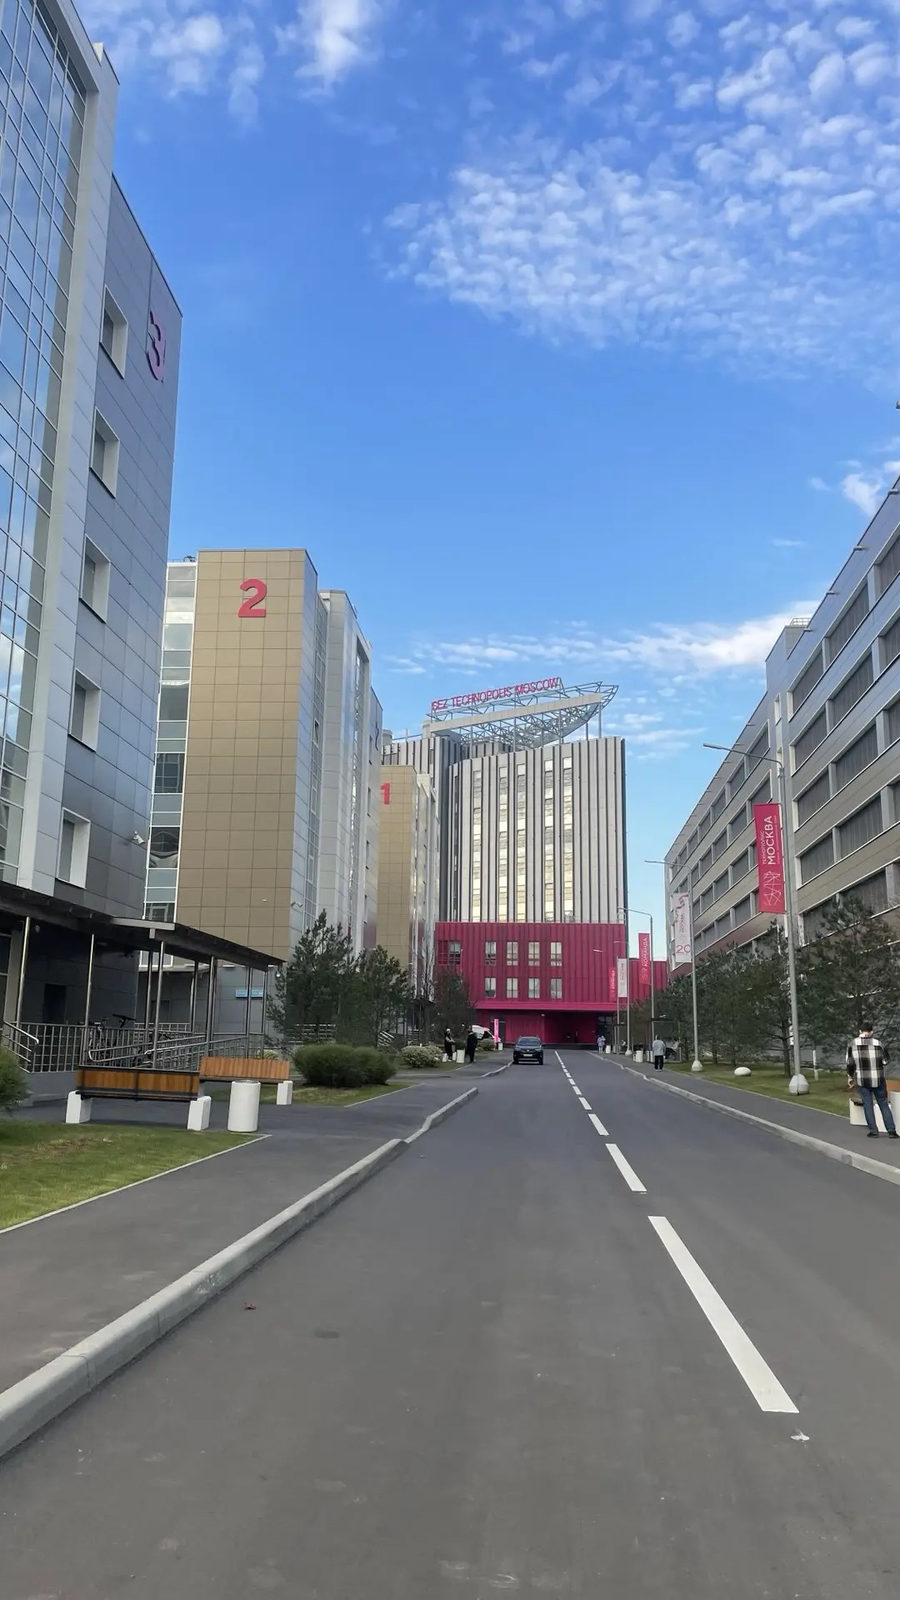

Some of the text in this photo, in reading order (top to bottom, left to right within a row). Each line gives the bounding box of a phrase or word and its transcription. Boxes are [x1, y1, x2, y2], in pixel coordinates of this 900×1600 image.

[146, 310, 167, 383] 3
[238, 578, 267, 618] 2
[431, 677, 559, 711] SEZ TECHNOPOLIS MOSCOW
[380, 782, 391, 805] 1
[764, 815, 776, 865] МОСКВА
